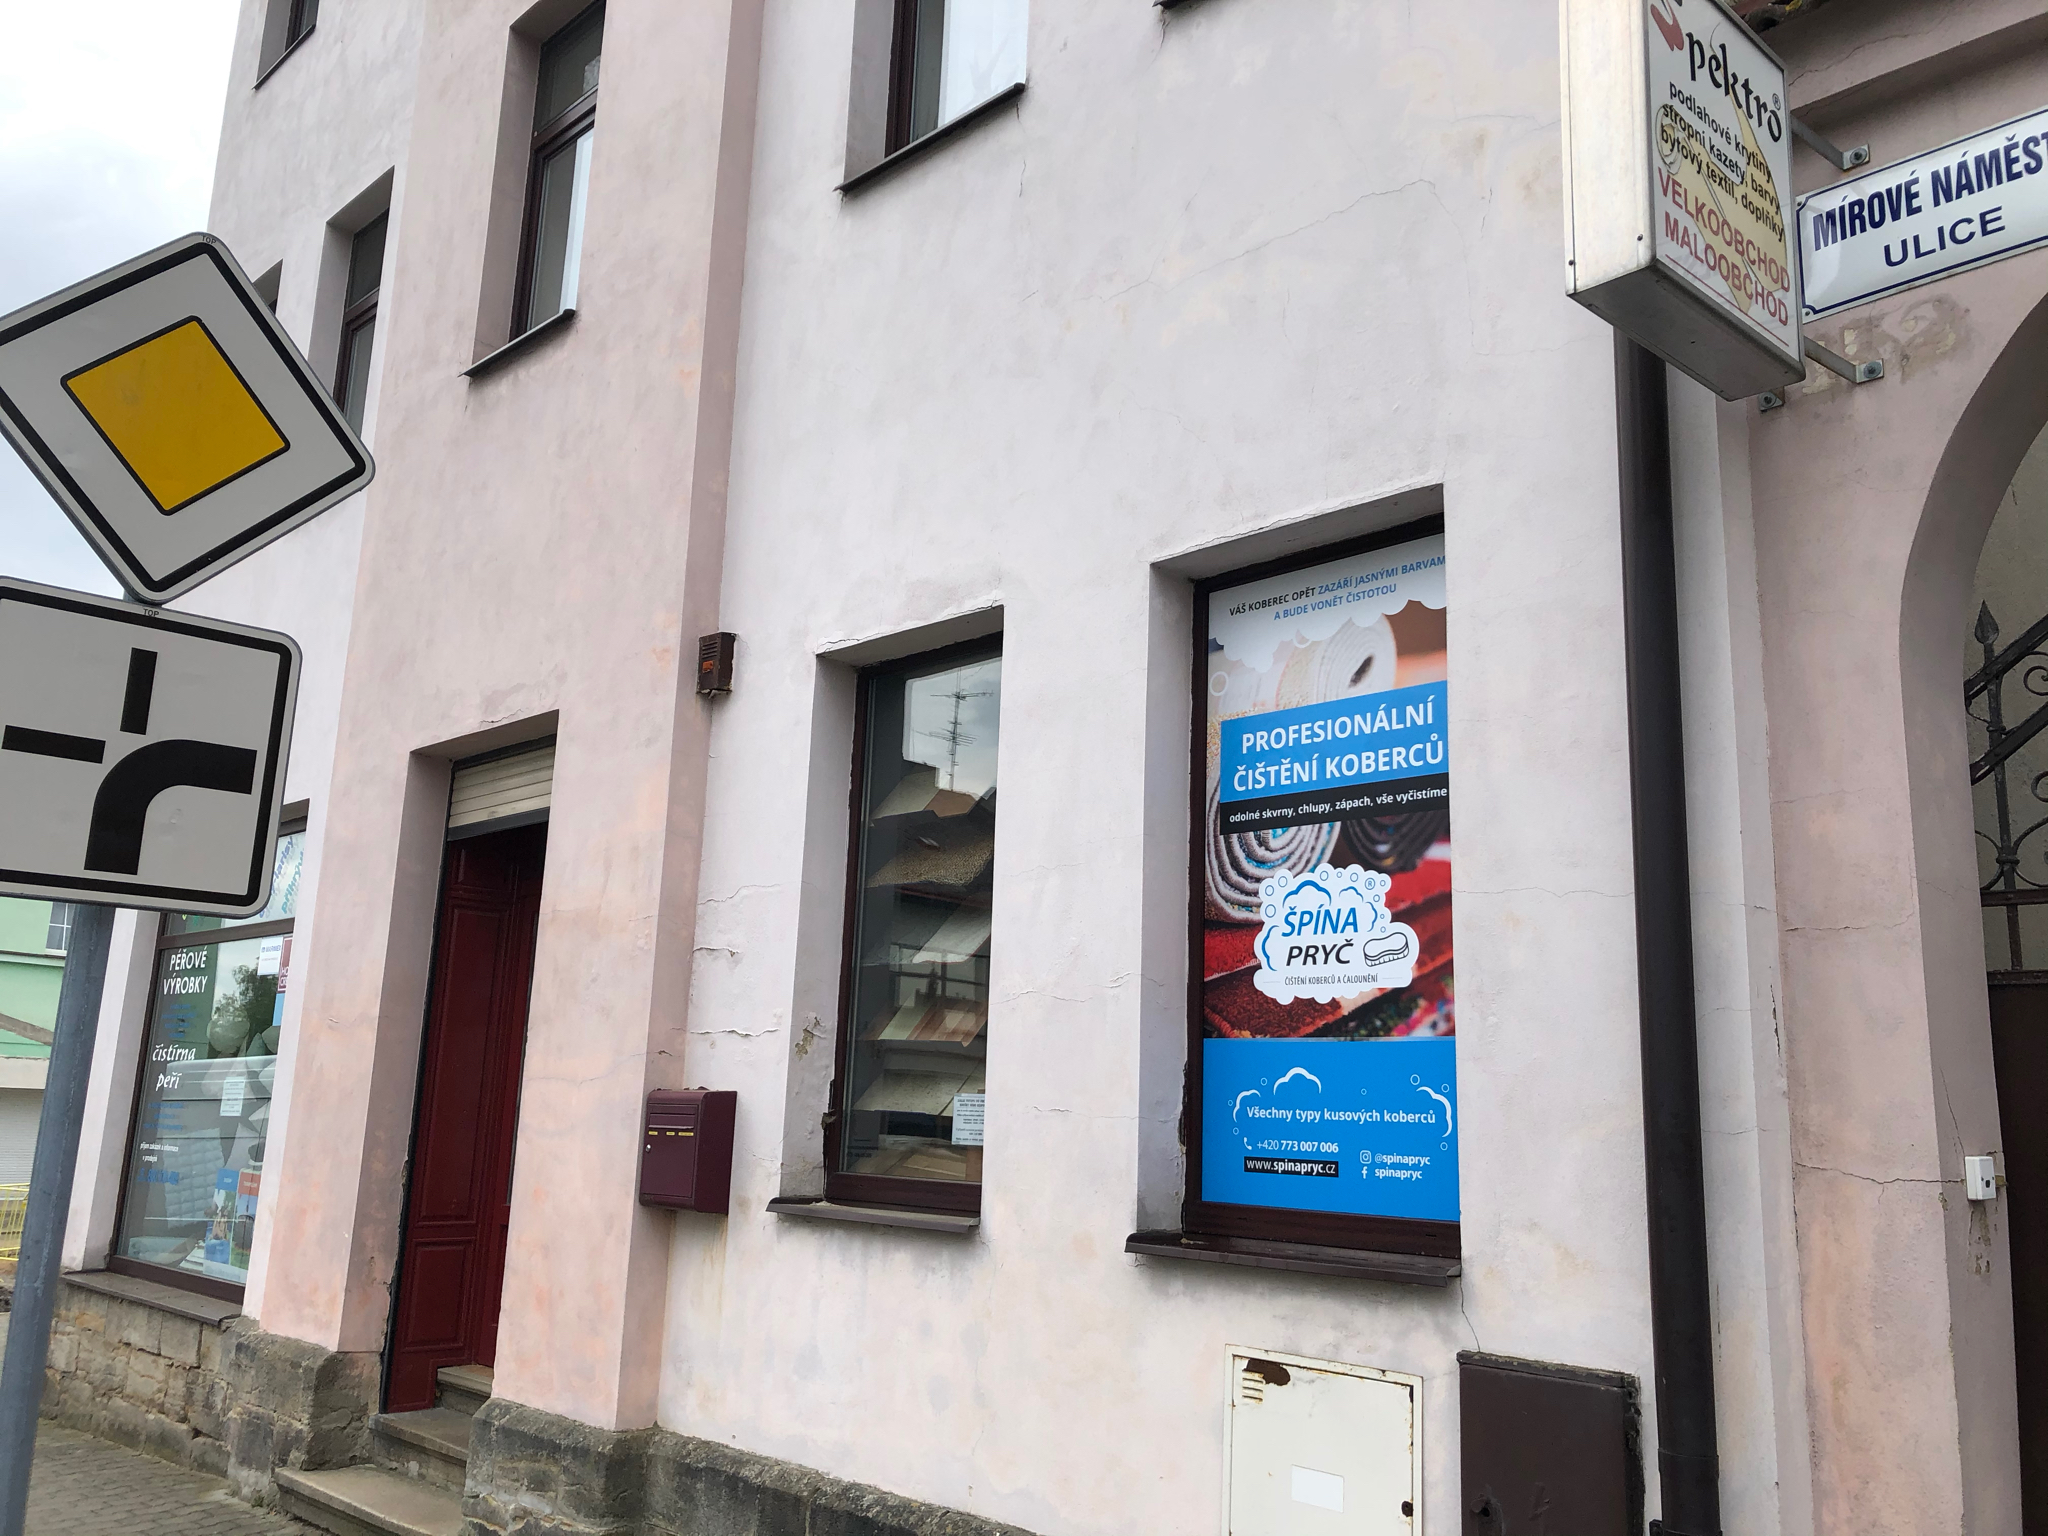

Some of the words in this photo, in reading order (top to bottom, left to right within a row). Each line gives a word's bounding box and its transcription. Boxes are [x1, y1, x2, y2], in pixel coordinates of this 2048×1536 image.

[1669, 81, 1732, 146] podlahové
[1734, 134, 1772, 184] krytiny
[1660, 122, 1703, 175] bytový
[1741, 191, 1785, 243] doplňky
[1708, 135, 1748, 188] kazety,
[1750, 172, 1781, 216] barvy
[1812, 169, 1922, 251] MÍROVÉ
[201, 235, 217, 245] TOP
[1658, 165, 1790, 293] VELKOOBCHOD
[1883, 205, 2006, 267] ULICE
[1665, 210, 1789, 327] MALOOBCHOD
[1229, 602, 1246, 616] VÁŠ
[1248, 594, 1290, 612] KOBEREC
[1291, 586, 1316, 601] OPĚT
[1317, 576, 1353, 595] ZAZÁŘÍ
[1354, 567, 1398, 588] JASNÝMI
[1274, 611, 1281, 620] A
[1283, 604, 1308, 619] BUDE
[1311, 595, 1344, 611] VONĚT
[1346, 583, 1397, 603] ČISTOTOU
[143, 607, 160, 617] TOP
[1241, 695, 1435, 755] PROFESIONÁLNÍ
[1233, 752, 1318, 792] ČIŠTĚNÍ
[1325, 733, 1444, 780] KOBERCŮ
[1229, 809, 1260, 823] odolné
[1262, 807, 1296, 820] skvrny,
[1298, 801, 1333, 816] chlupy,
[1335, 796, 1374, 812] zápach,
[1376, 792, 1393, 804] vše
[1396, 786, 1448, 803] vyčistíme
[1281, 904, 1358, 937] ŠPÍNA
[169, 945, 208, 971] PÉŘOVÉ
[1286, 938, 1354, 967] PRYČ
[163, 972, 208, 995] VÝROBKY
[1284, 975, 1307, 985] ČIŠTĚNÍ
[1308, 974, 1336, 985] KOBERCŮ
[1336, 974, 1342, 984] A
[1342, 973, 1379, 984] ČALOUNĚNÍ
[152, 1044, 197, 1062] čistírna
[155, 1072, 182, 1091] peří
[1246, 1106, 1293, 1122] Všechny
[1295, 1109, 1321, 1123] typy
[1324, 1108, 1380, 1124] kusových
[1383, 1109, 1436, 1123] koberců
[1256, 1139, 1279, 1150] +420
[1280, 1140, 1298, 1151] 773
[1300, 1141, 1318, 1152] 007
[1320, 1142, 1339, 1153] 006
[1374, 1152, 1431, 1167] @spinapryc
[1246, 1158, 1336, 1175] www.spinapryc.cz
[1374, 1166, 1422, 1181] spinapryc
